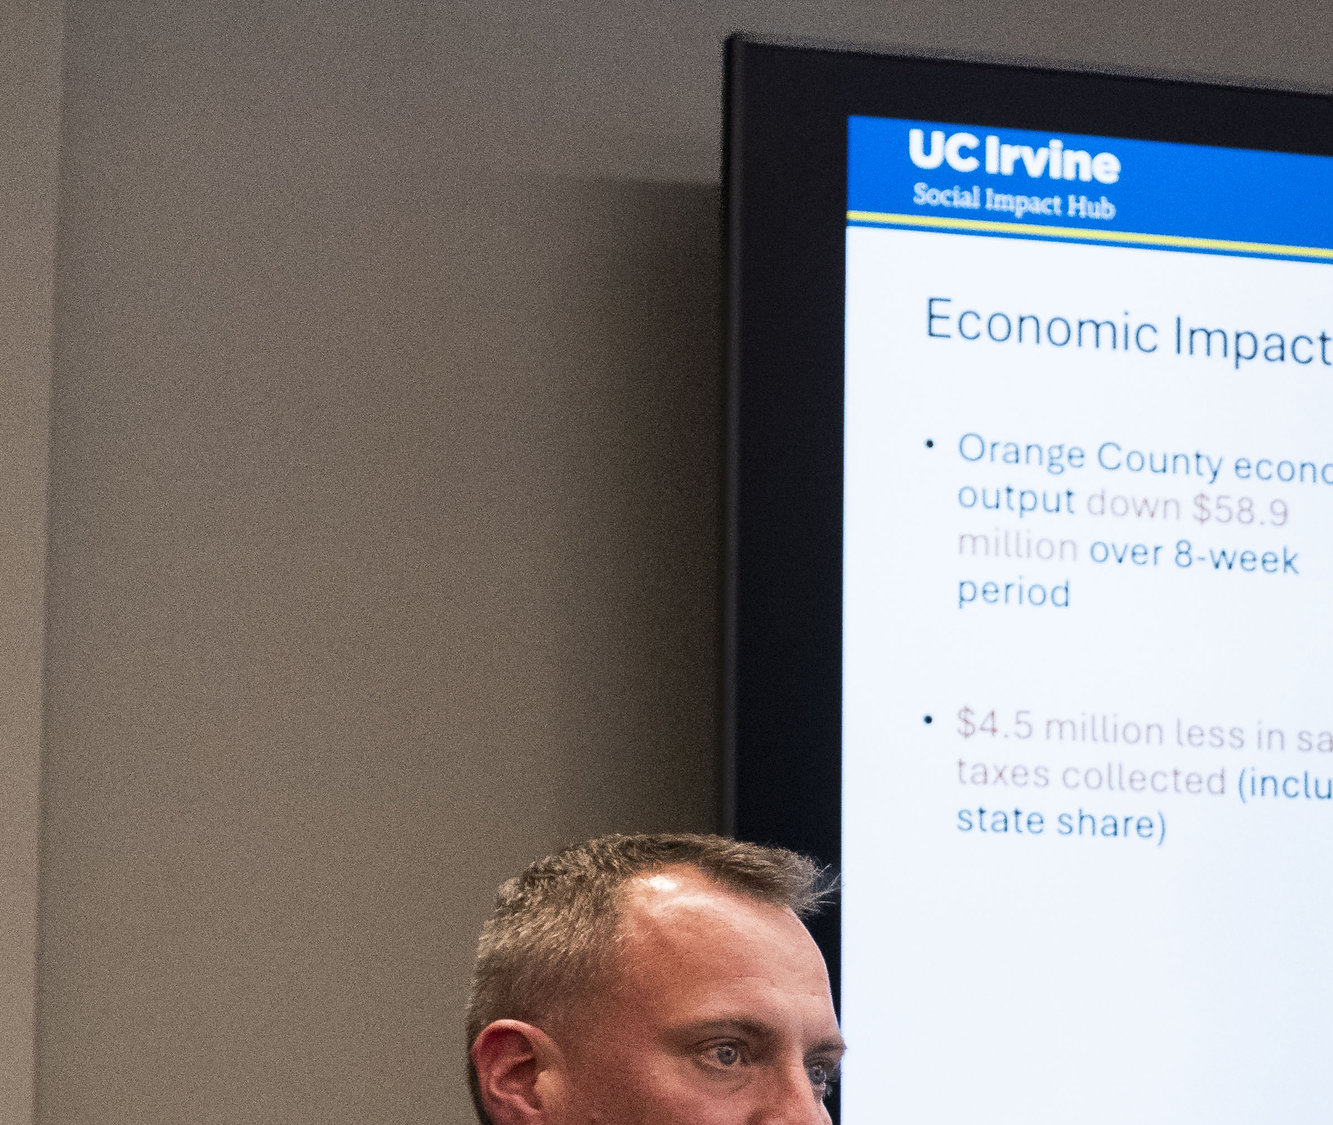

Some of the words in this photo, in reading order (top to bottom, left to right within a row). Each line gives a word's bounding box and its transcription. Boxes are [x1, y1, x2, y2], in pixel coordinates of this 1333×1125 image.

[909, 128, 978, 172] UC
[985, 133, 1121, 184] Irvine
[912, 182, 980, 210] Social
[985, 189, 1062, 217] Impact
[1067, 193, 1116, 221] Hub
[926, 296, 1159, 355] Economic
[958, 432, 1085, 475] Orange
[1097, 441, 1223, 485] County
[958, 483, 1076, 518] output
[1086, 488, 1182, 522] down
[1192, 491, 1289, 529] $58.9
[957, 529, 1078, 563] million
[1089, 542, 1163, 567] over
[1174, 539, 1300, 576] 8-week
[958, 574, 1072, 611] period
[956, 705, 1034, 741] $4.5
[1045, 713, 1164, 747] million
[1175, 718, 1246, 751] less
[1257, 720, 1286, 752] in
[957, 758, 1050, 789] taxes
[1061, 763, 1226, 796] collected
[956, 805, 1045, 834] state
[1056, 809, 1168, 846] share)
